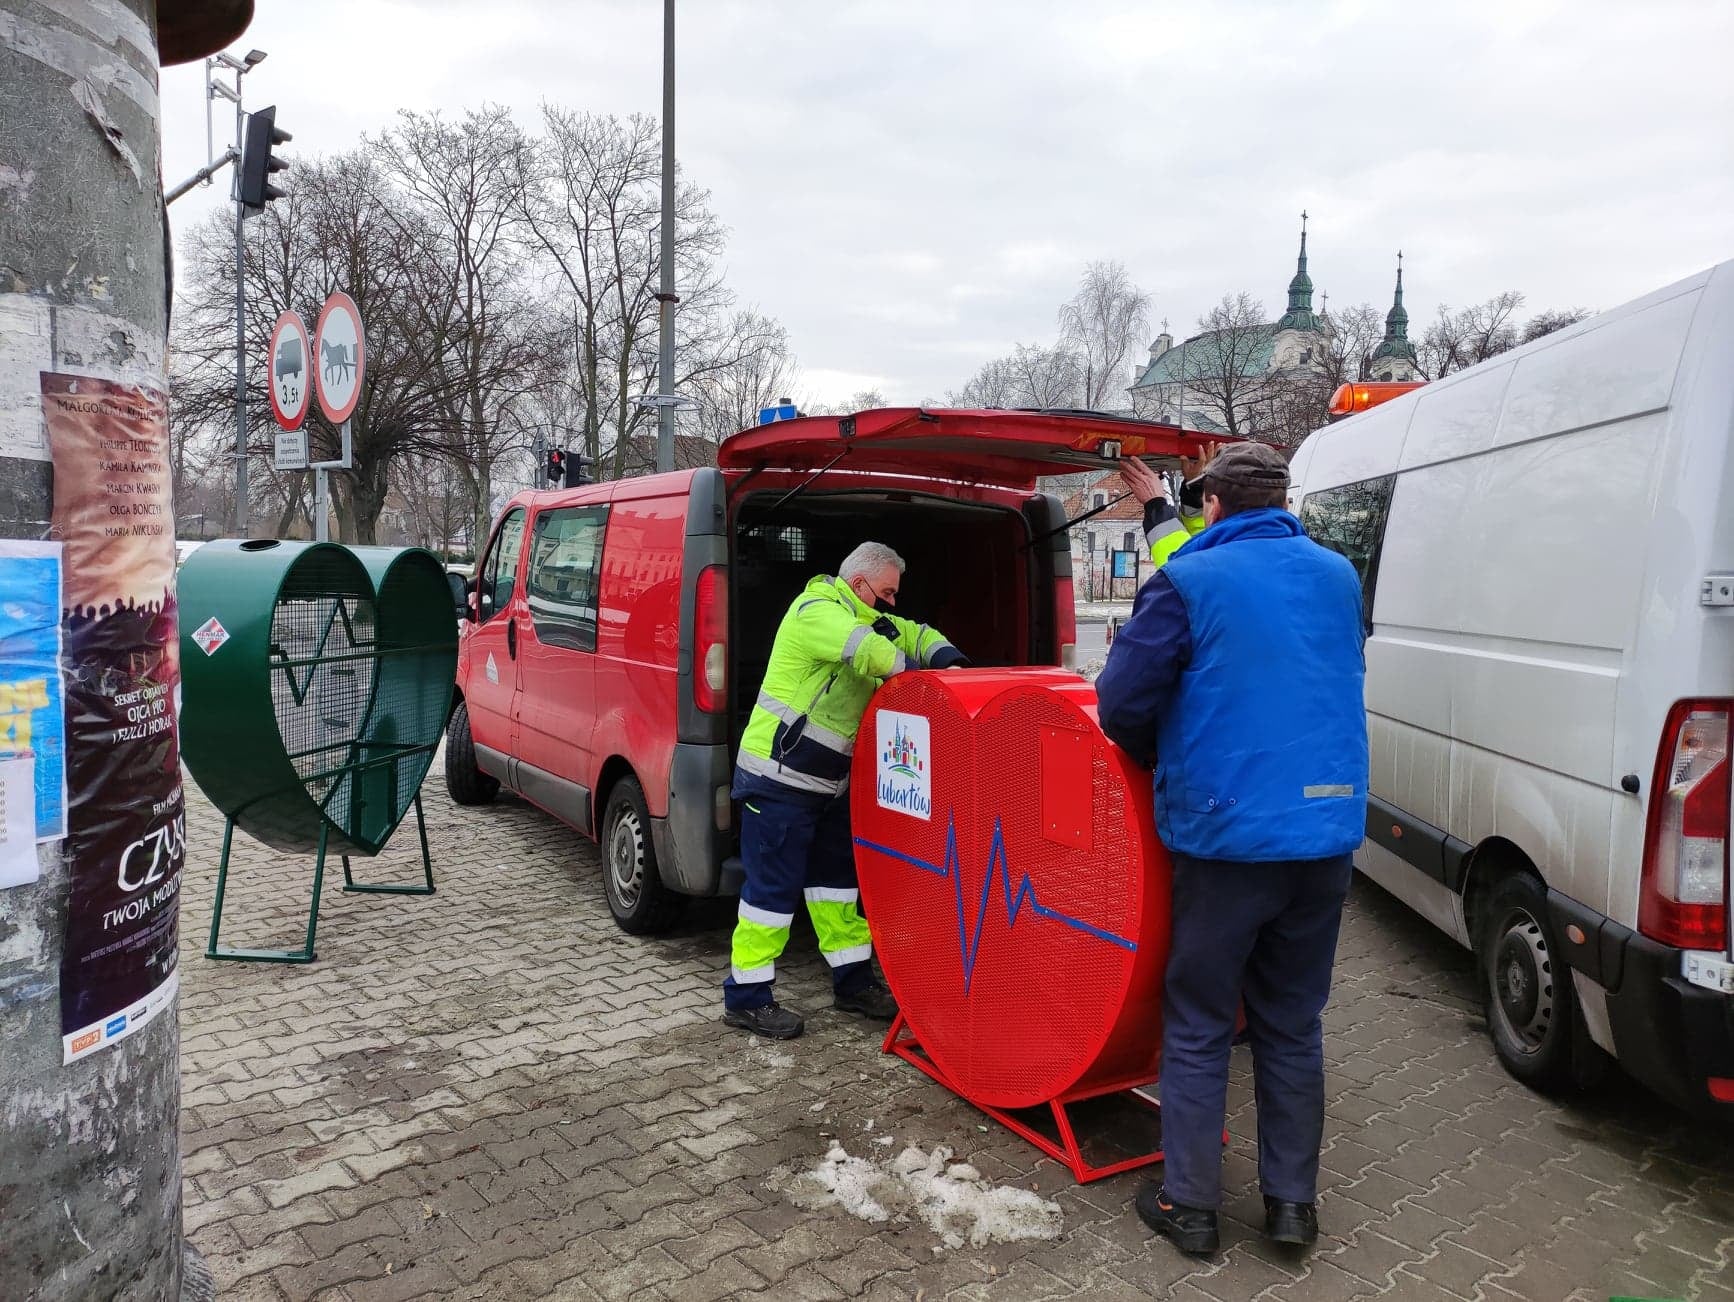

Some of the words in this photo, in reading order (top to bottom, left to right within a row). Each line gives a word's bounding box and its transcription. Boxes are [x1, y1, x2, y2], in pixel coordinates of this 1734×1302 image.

[100, 461, 129, 472] KAMILA
[109, 505, 131, 515] OLGA
[105, 527, 129, 537] MARIA
[114, 689, 141, 707] SEKRET
[127, 704, 151, 723] OJCA
[152, 698, 166, 715] PIO
[877, 773, 931, 815] Lubartów
[102, 895, 151, 930] TWOJA
